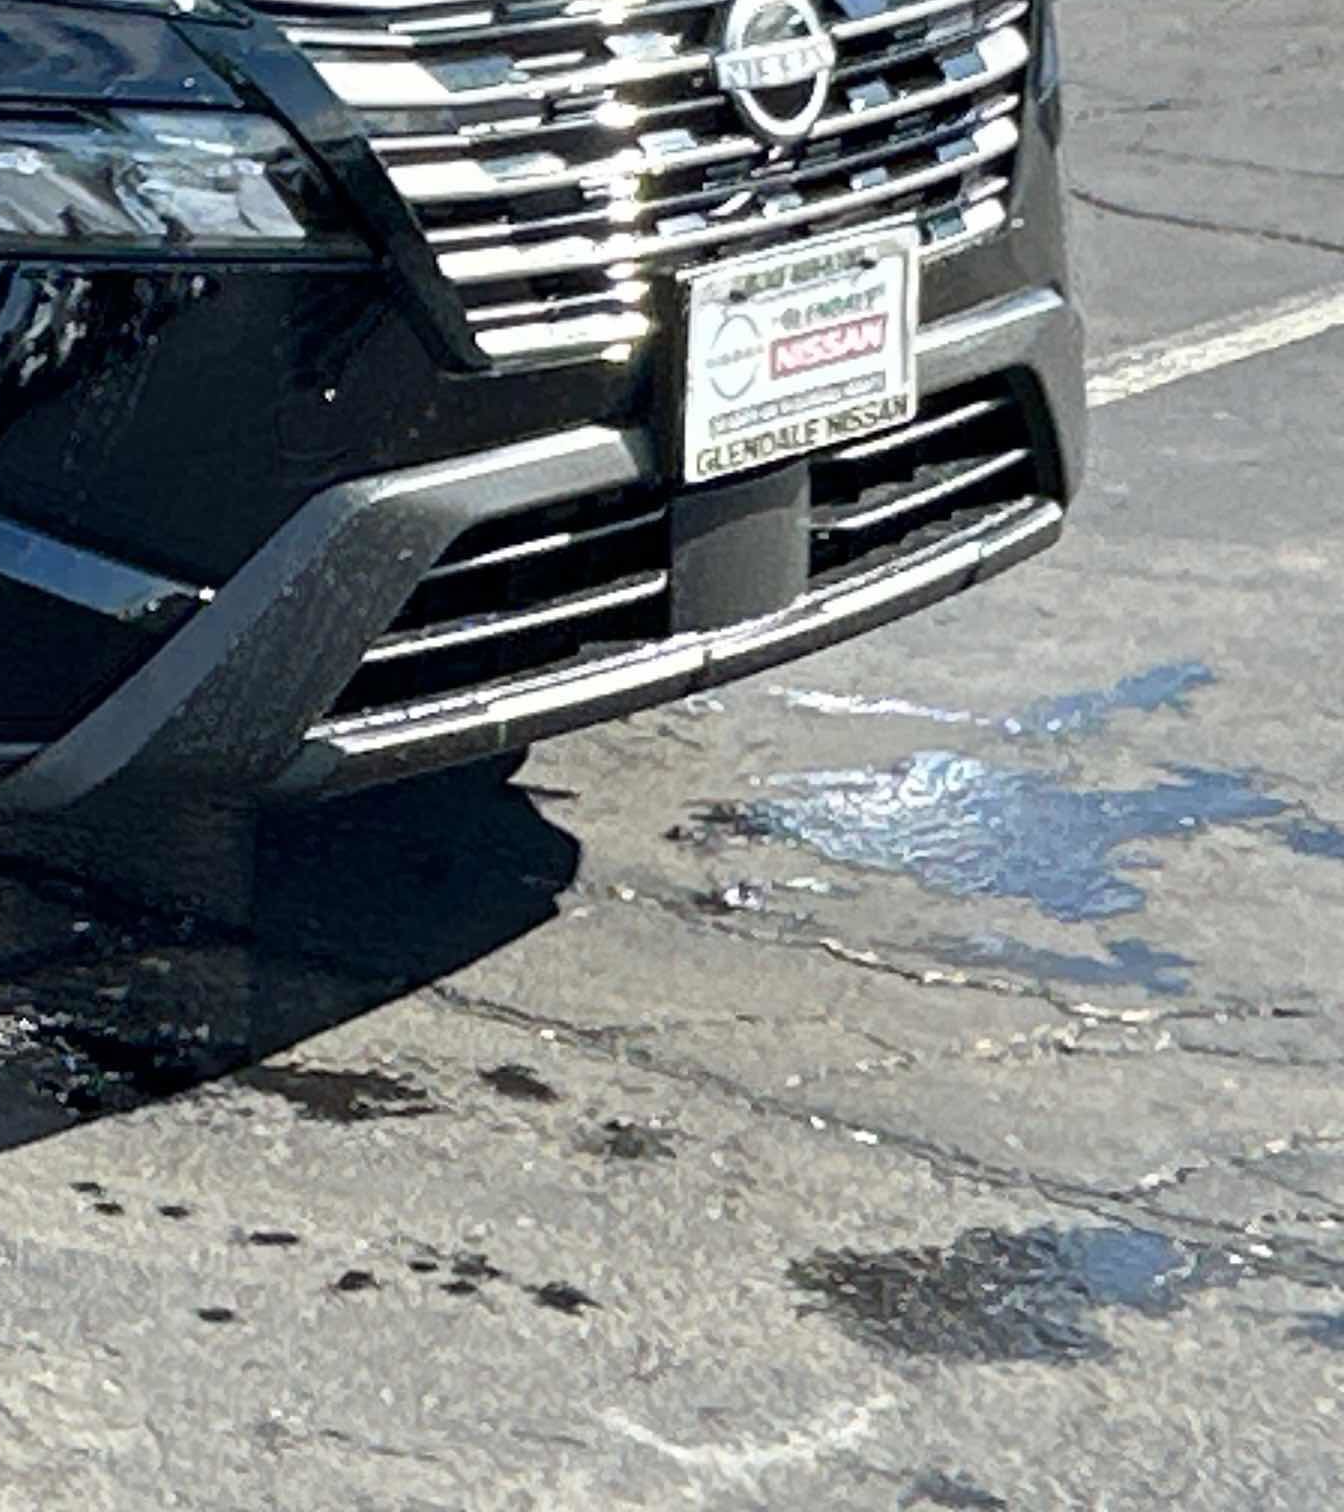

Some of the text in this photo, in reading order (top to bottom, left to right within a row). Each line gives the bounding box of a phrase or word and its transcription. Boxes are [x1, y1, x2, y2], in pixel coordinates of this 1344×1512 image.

[776, 320, 886, 373] NISSAN
[696, 418, 819, 475] GLENDALE
[826, 393, 908, 439] NISSAN
